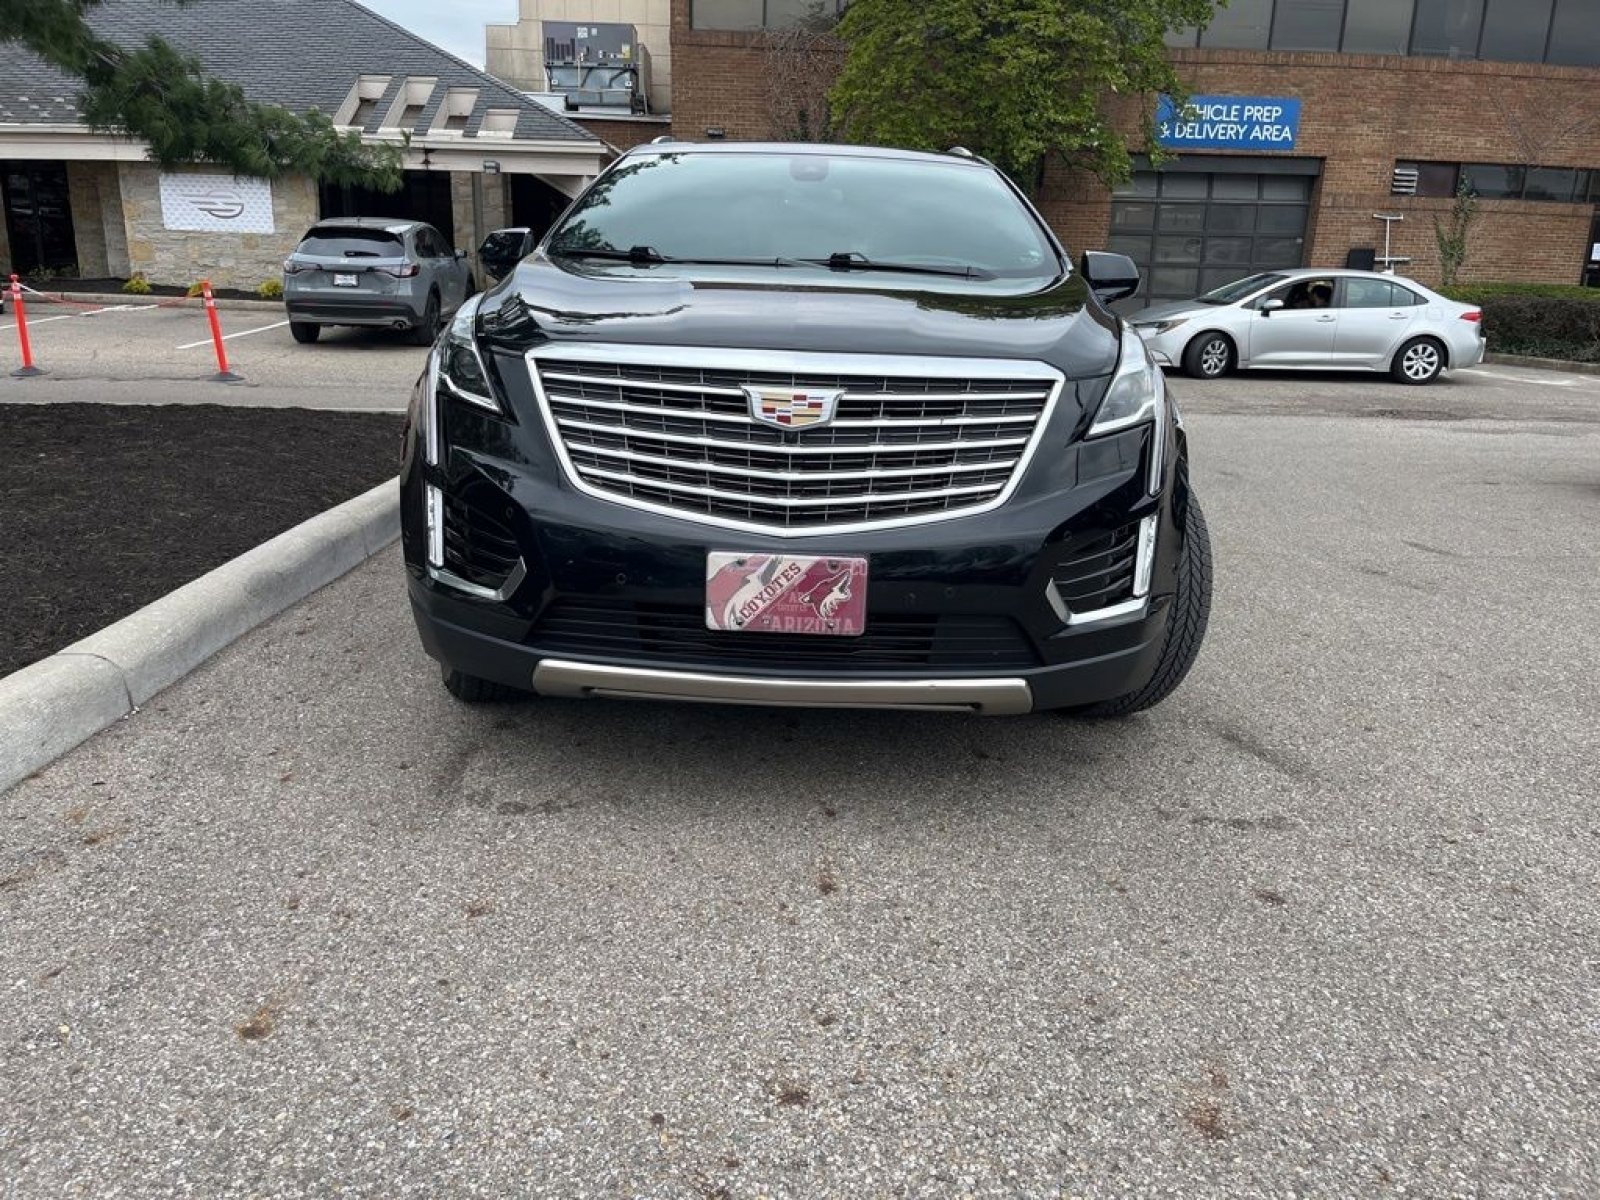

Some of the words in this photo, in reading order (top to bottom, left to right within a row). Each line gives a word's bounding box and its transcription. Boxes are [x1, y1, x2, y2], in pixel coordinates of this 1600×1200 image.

[1174, 103, 1240, 121] HICLE
[1244, 105, 1282, 123] PREP
[1175, 122, 1247, 140] DELIVERY
[1250, 124, 1292, 142] AREA
[739, 562, 801, 619] COYOTES
